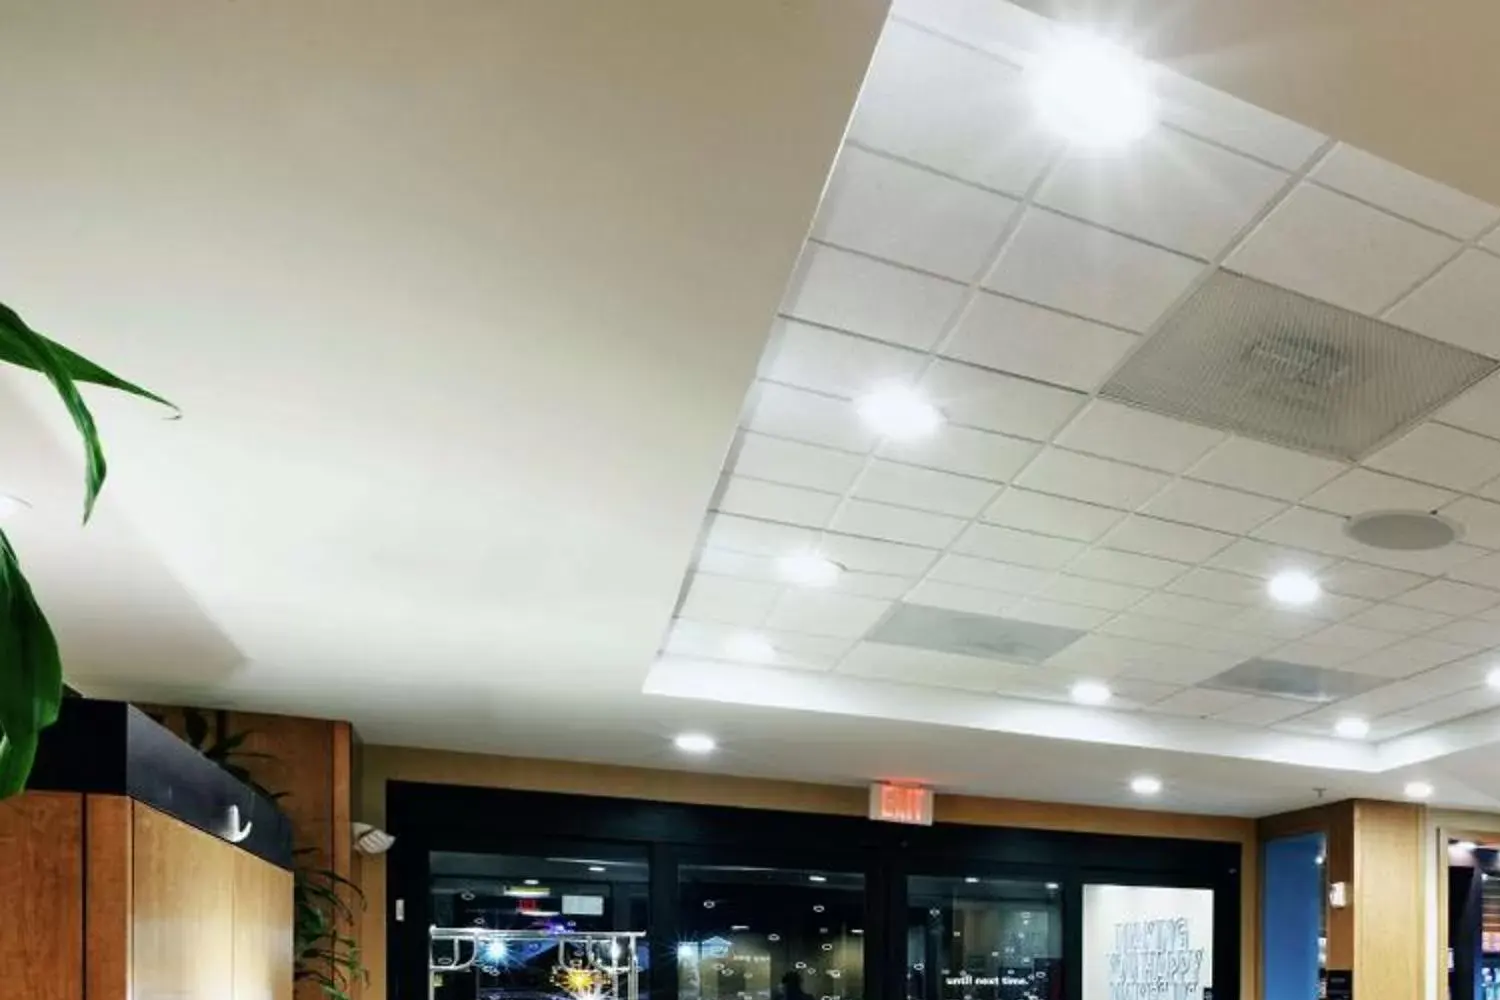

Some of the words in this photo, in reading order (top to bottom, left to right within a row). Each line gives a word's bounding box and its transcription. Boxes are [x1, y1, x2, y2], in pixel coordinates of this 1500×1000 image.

[881, 787, 923, 821] EXIT
[946, 975, 972, 985] until
[975, 977, 999, 986] next
[1001, 976, 1028, 985] time.
